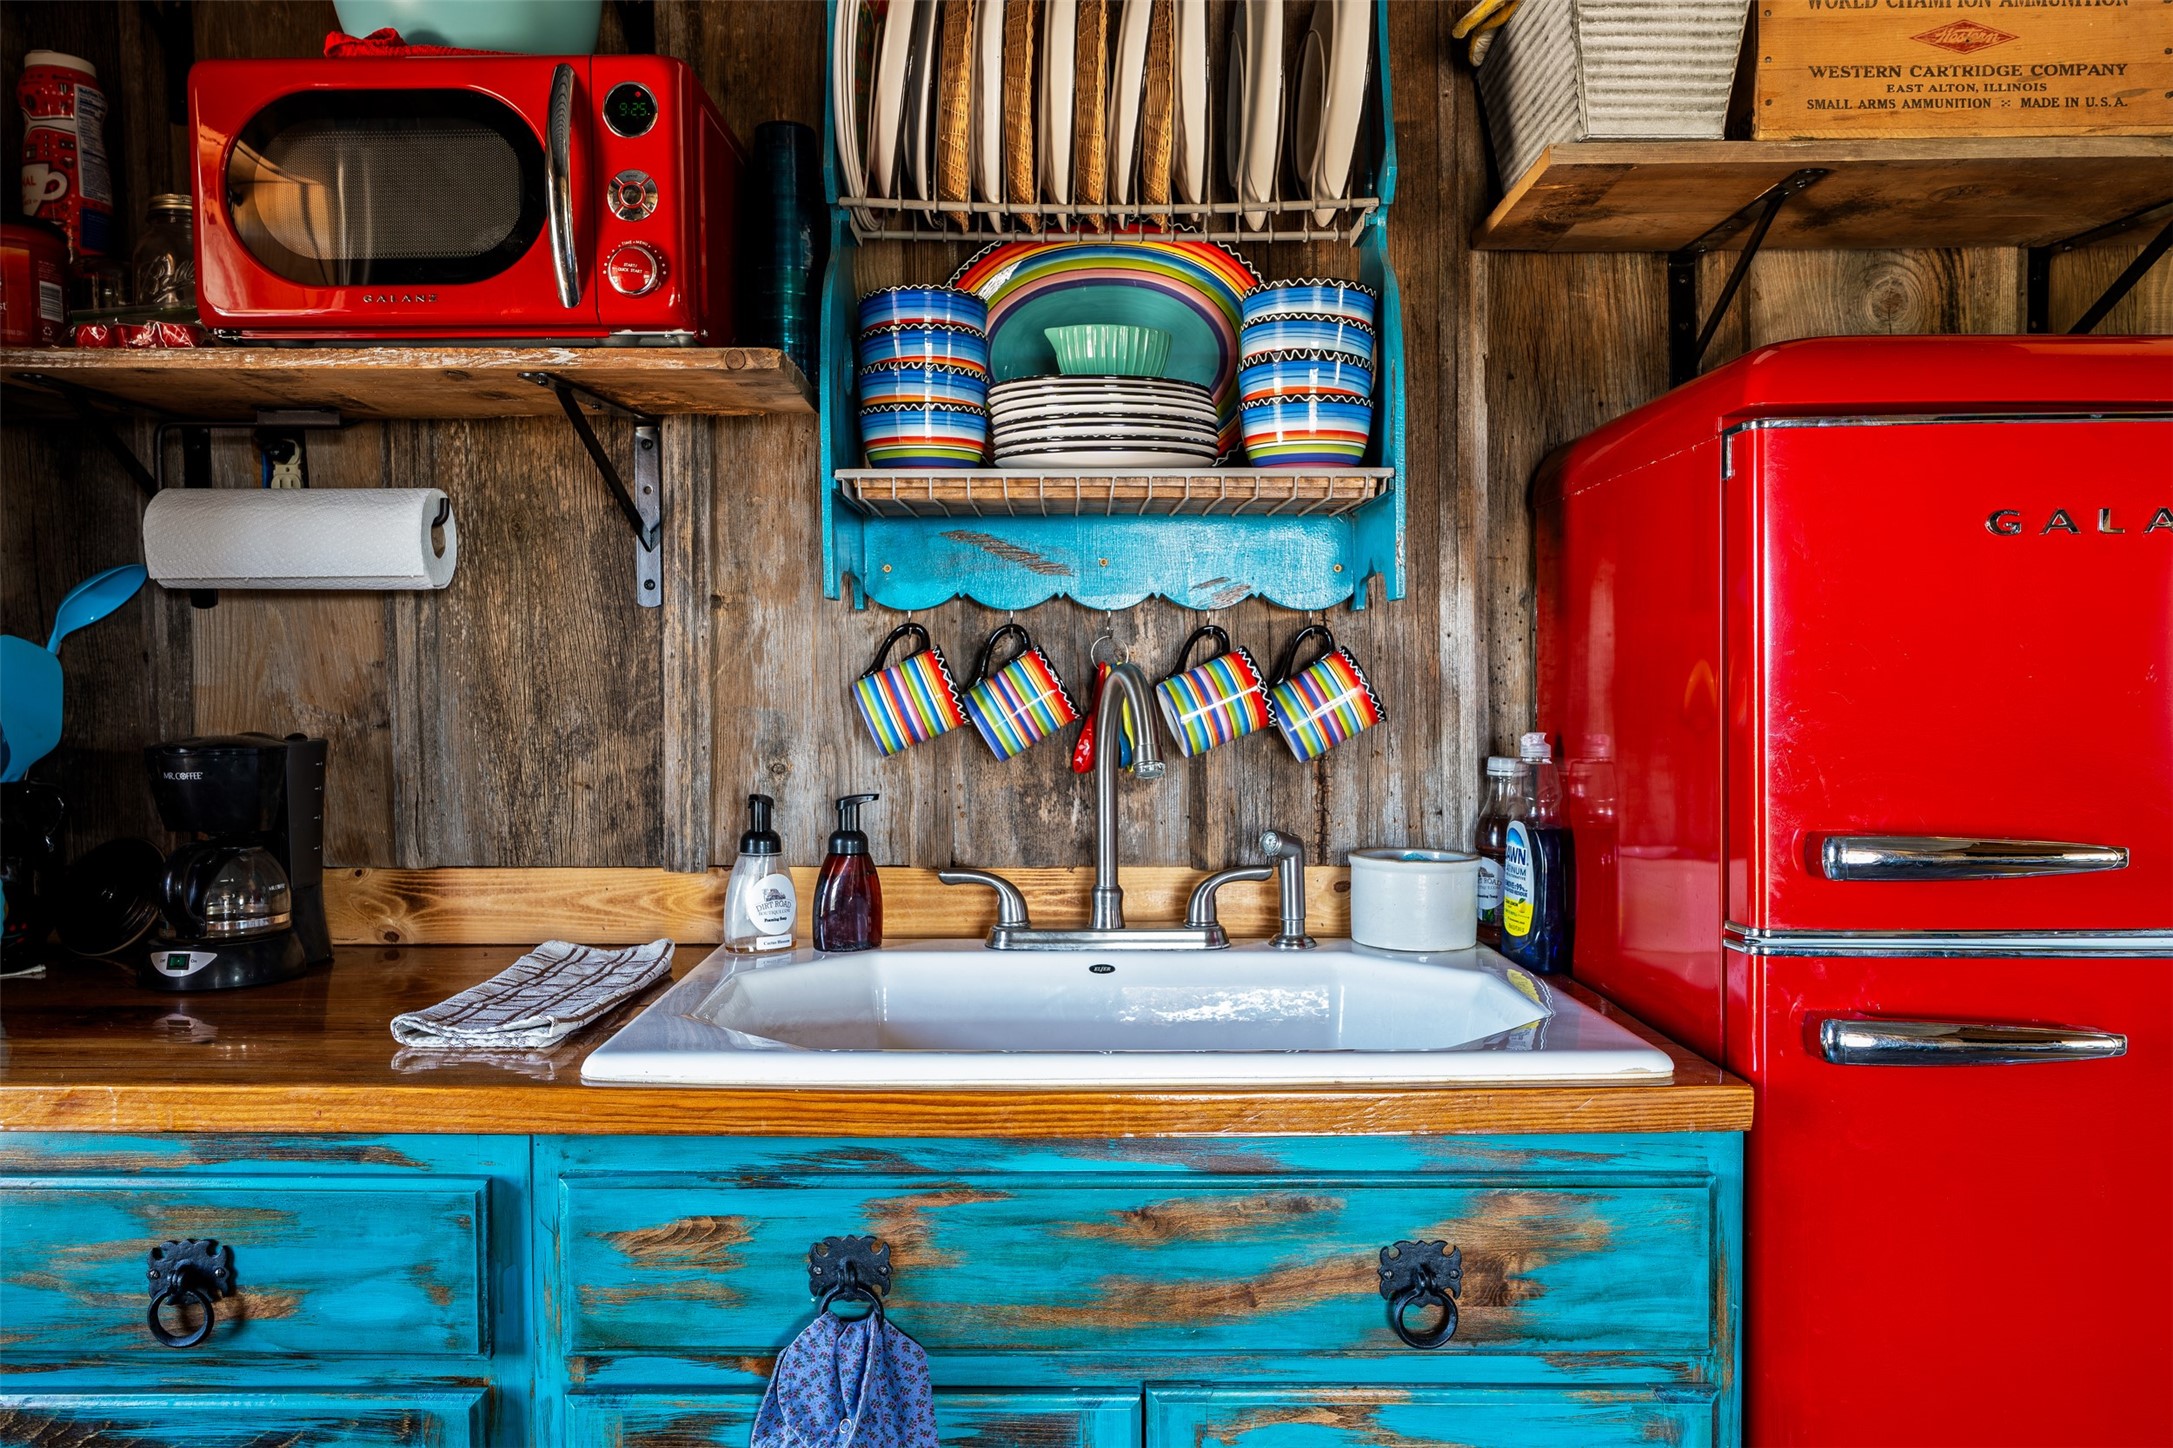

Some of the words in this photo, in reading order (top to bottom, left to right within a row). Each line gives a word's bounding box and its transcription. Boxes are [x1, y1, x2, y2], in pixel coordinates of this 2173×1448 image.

[1809, 0, 1877, 9] WORLD
[1808, 65, 1901, 78] WESTERN
[1910, 64, 2022, 78] CARTRIDGE
[2030, 63, 2128, 76] COMPANY
[1886, 84, 1923, 93] EAST
[1928, 83, 1979, 93] ALTON,
[1983, 83, 2047, 92] ILLINOIS
[1807, 99, 1852, 109] SMALL
[1858, 99, 1896, 109] ARMS
[1902, 98, 1991, 109] AMMUNITION
[2020, 98, 2060, 107] MADE
[2065, 97, 2079, 108] IN
[756, 901, 773, 912] DIRT
[774, 900, 791, 908] ROAD
